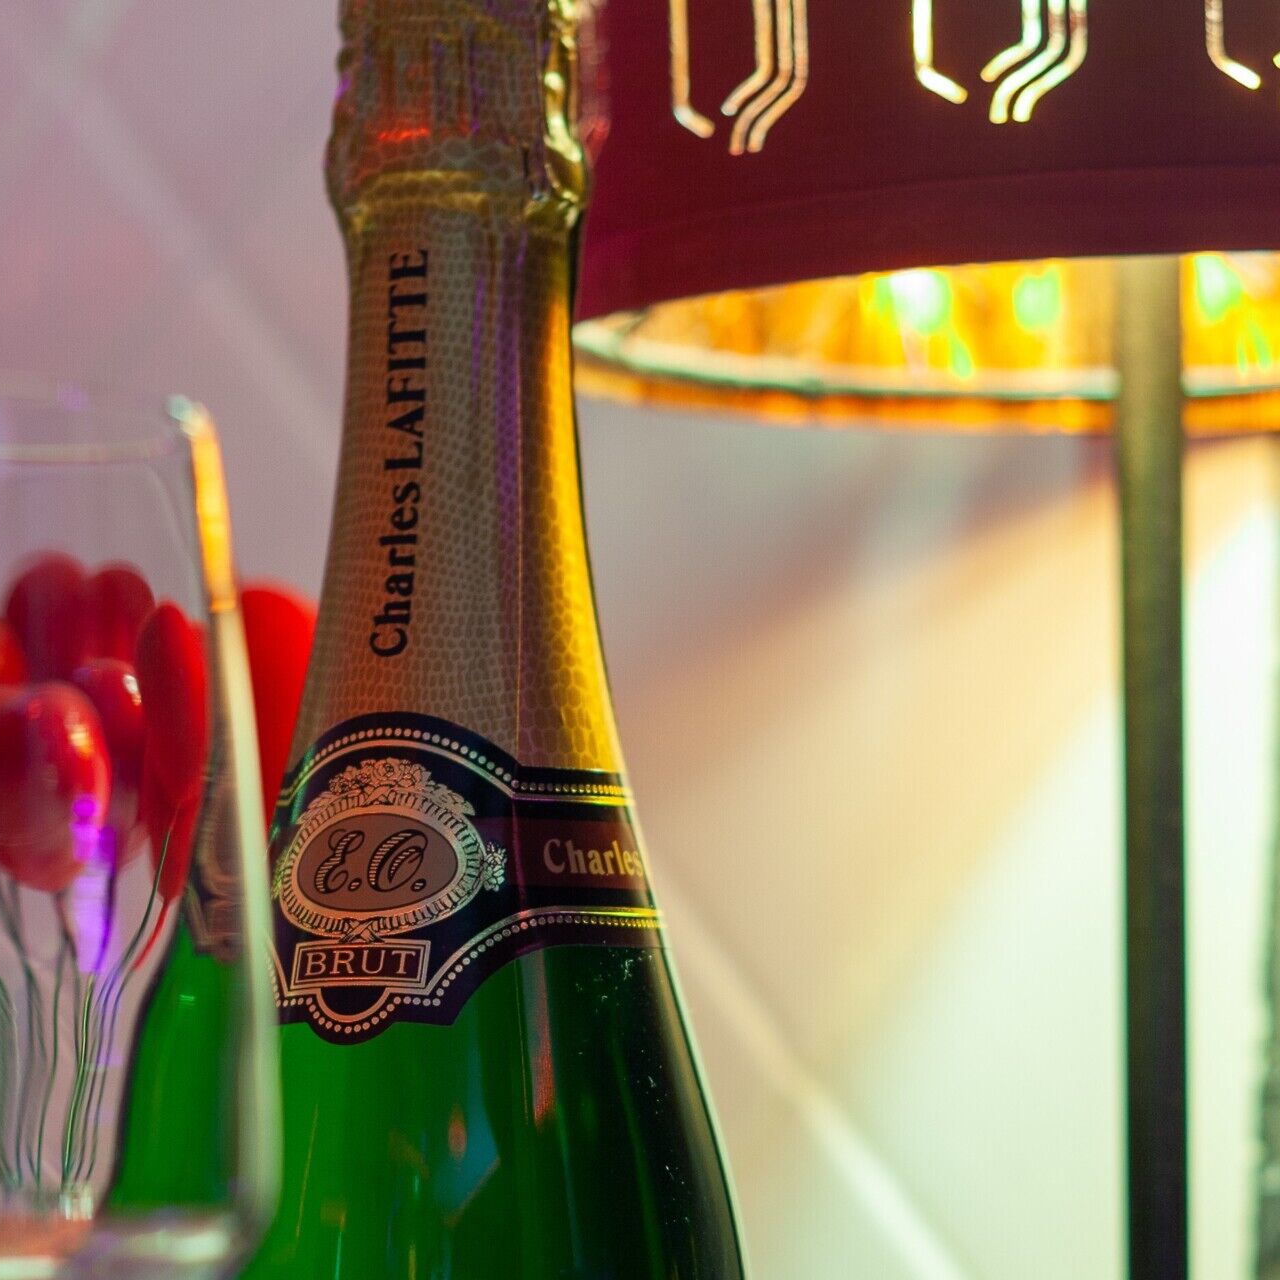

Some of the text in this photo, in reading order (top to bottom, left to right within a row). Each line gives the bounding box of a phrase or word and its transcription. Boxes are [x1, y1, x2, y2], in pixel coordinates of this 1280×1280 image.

[370, 250, 428, 657] Charles LAFITTE
[543, 838, 644, 877] Charles
[305, 949, 416, 976] BRUT
